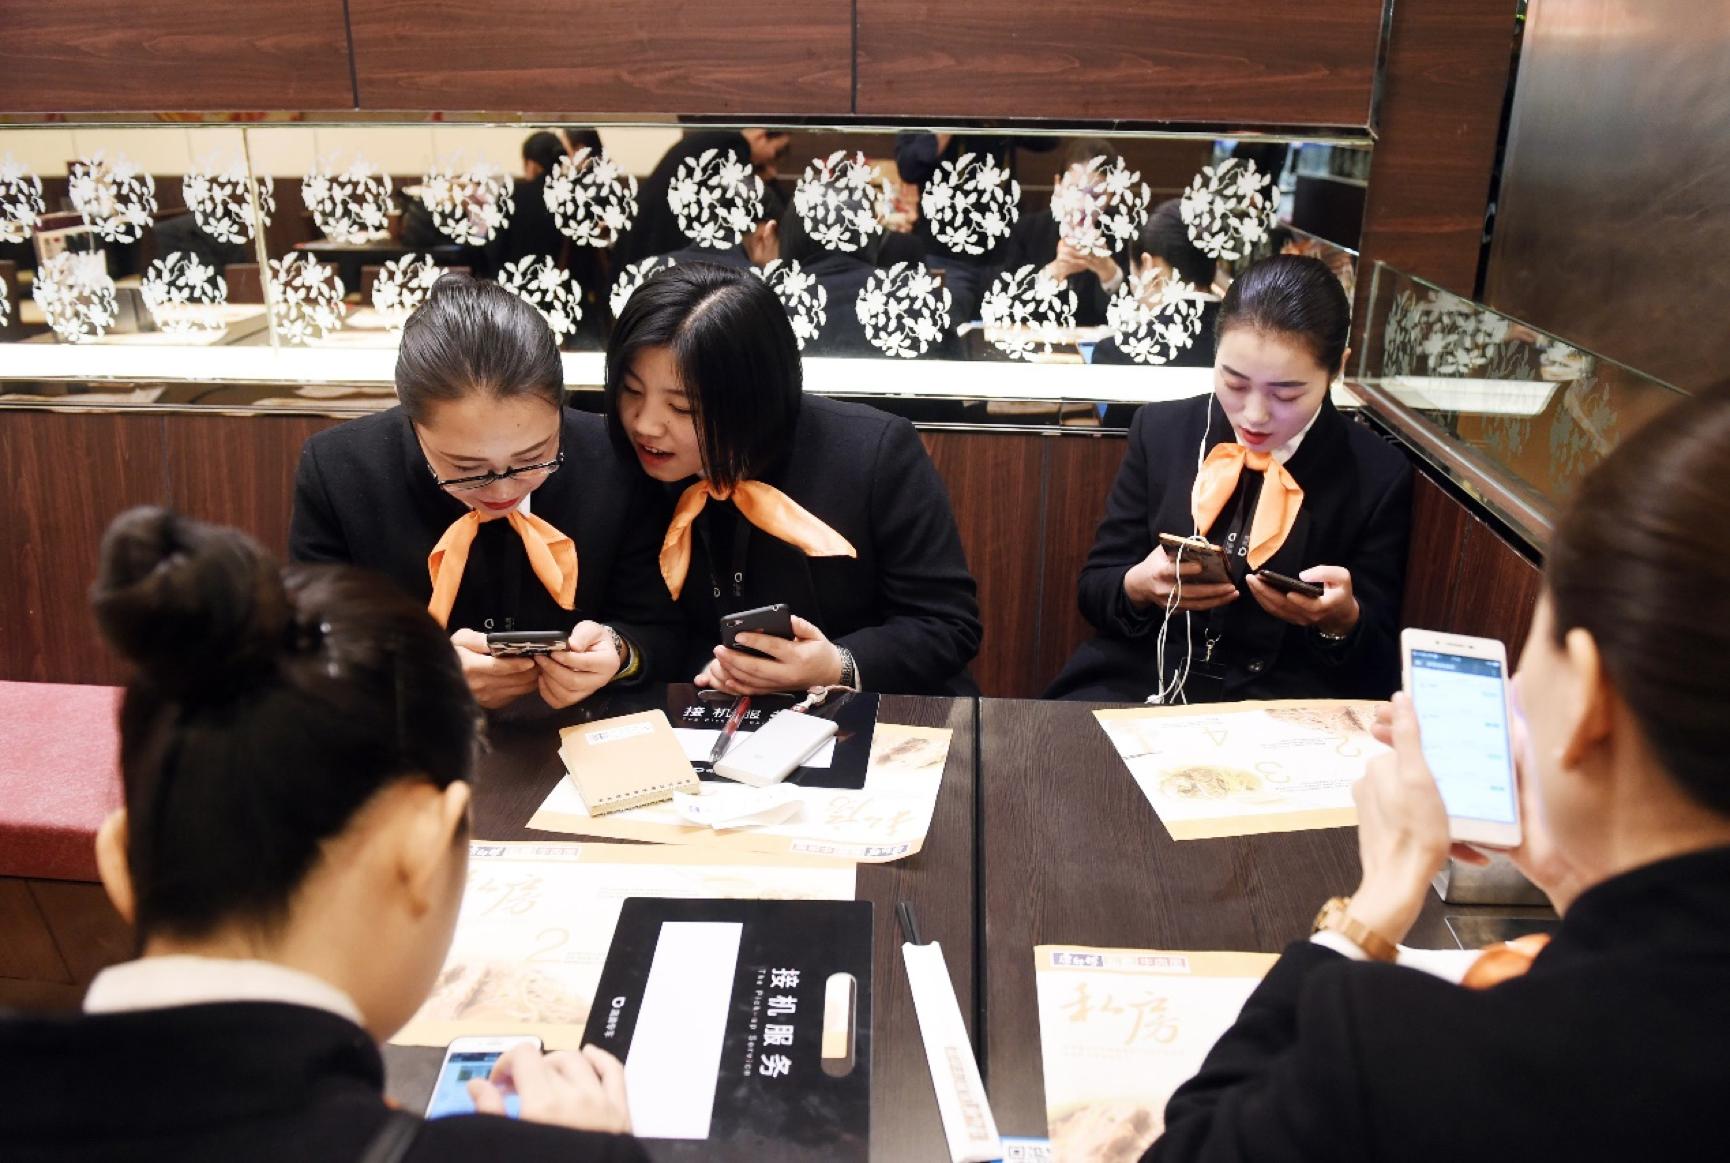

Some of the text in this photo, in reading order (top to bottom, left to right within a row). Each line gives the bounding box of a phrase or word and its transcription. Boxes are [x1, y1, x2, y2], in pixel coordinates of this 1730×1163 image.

[682, 705, 779, 720] 接机服
[743, 967, 767, 1077] The Pick-up Service
[759, 967, 801, 1078] 接机服务
